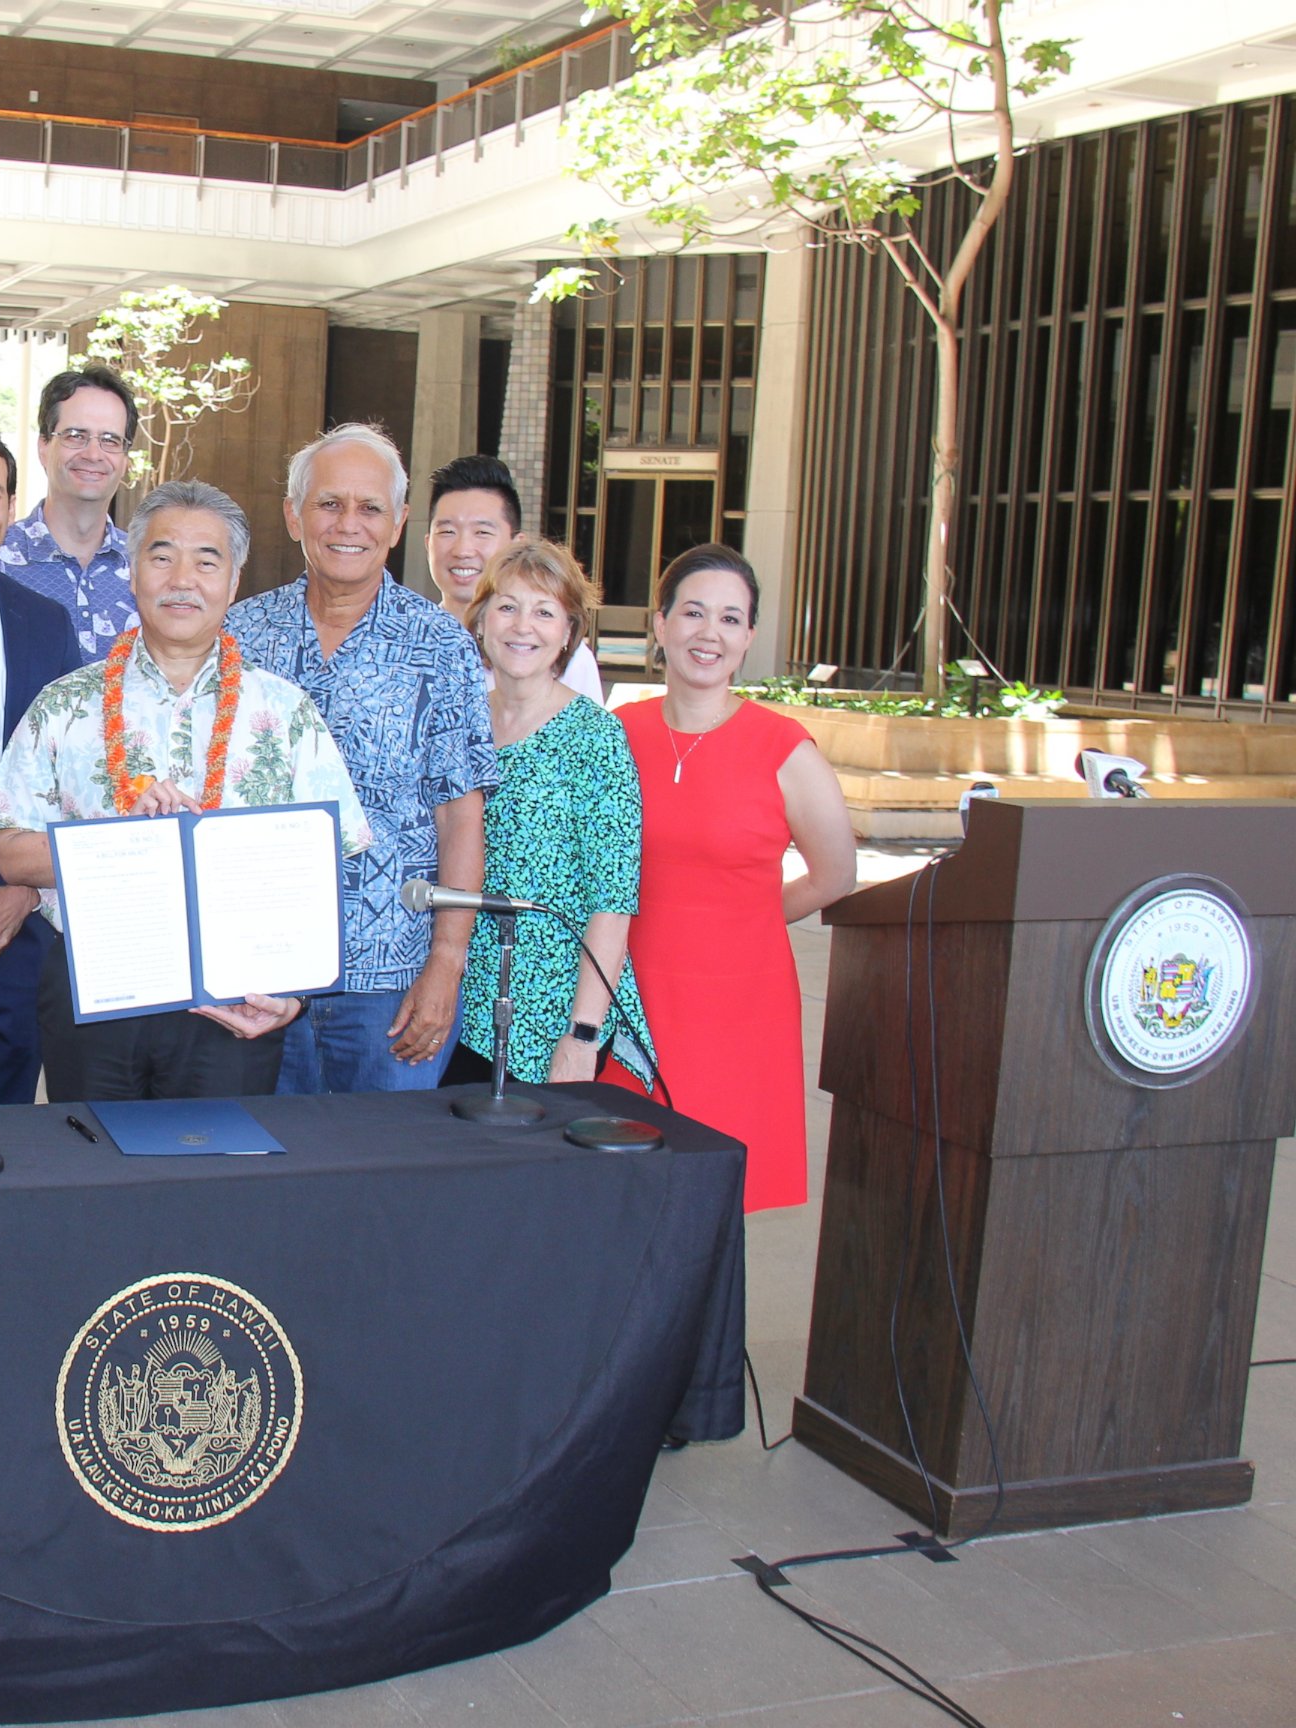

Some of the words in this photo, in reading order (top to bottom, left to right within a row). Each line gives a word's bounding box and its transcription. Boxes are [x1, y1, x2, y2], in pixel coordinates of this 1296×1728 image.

[639, 455, 681, 466] SENATE
[1124, 905, 1166, 947] STATE
[1174, 901, 1194, 911] OF
[1200, 904, 1240, 945] HAWAII
[1168, 923, 1199, 934] 1959
[85, 1291, 154, 1349] STATE
[168, 1284, 200, 1299] OF
[212, 1289, 280, 1351] HAWAII
[158, 1315, 210, 1332] 1959
[68, 1418, 86, 1441] UA
[78, 1446, 105, 1481] MAU
[102, 1480, 122, 1500] KE
[123, 1493, 143, 1513] EA
[149, 1504, 159, 1518] O
[164, 1504, 185, 1519] KA
[195, 1494, 234, 1518] AINA
[249, 1464, 270, 1487] KA
[266, 1415, 291, 1460] PONO
